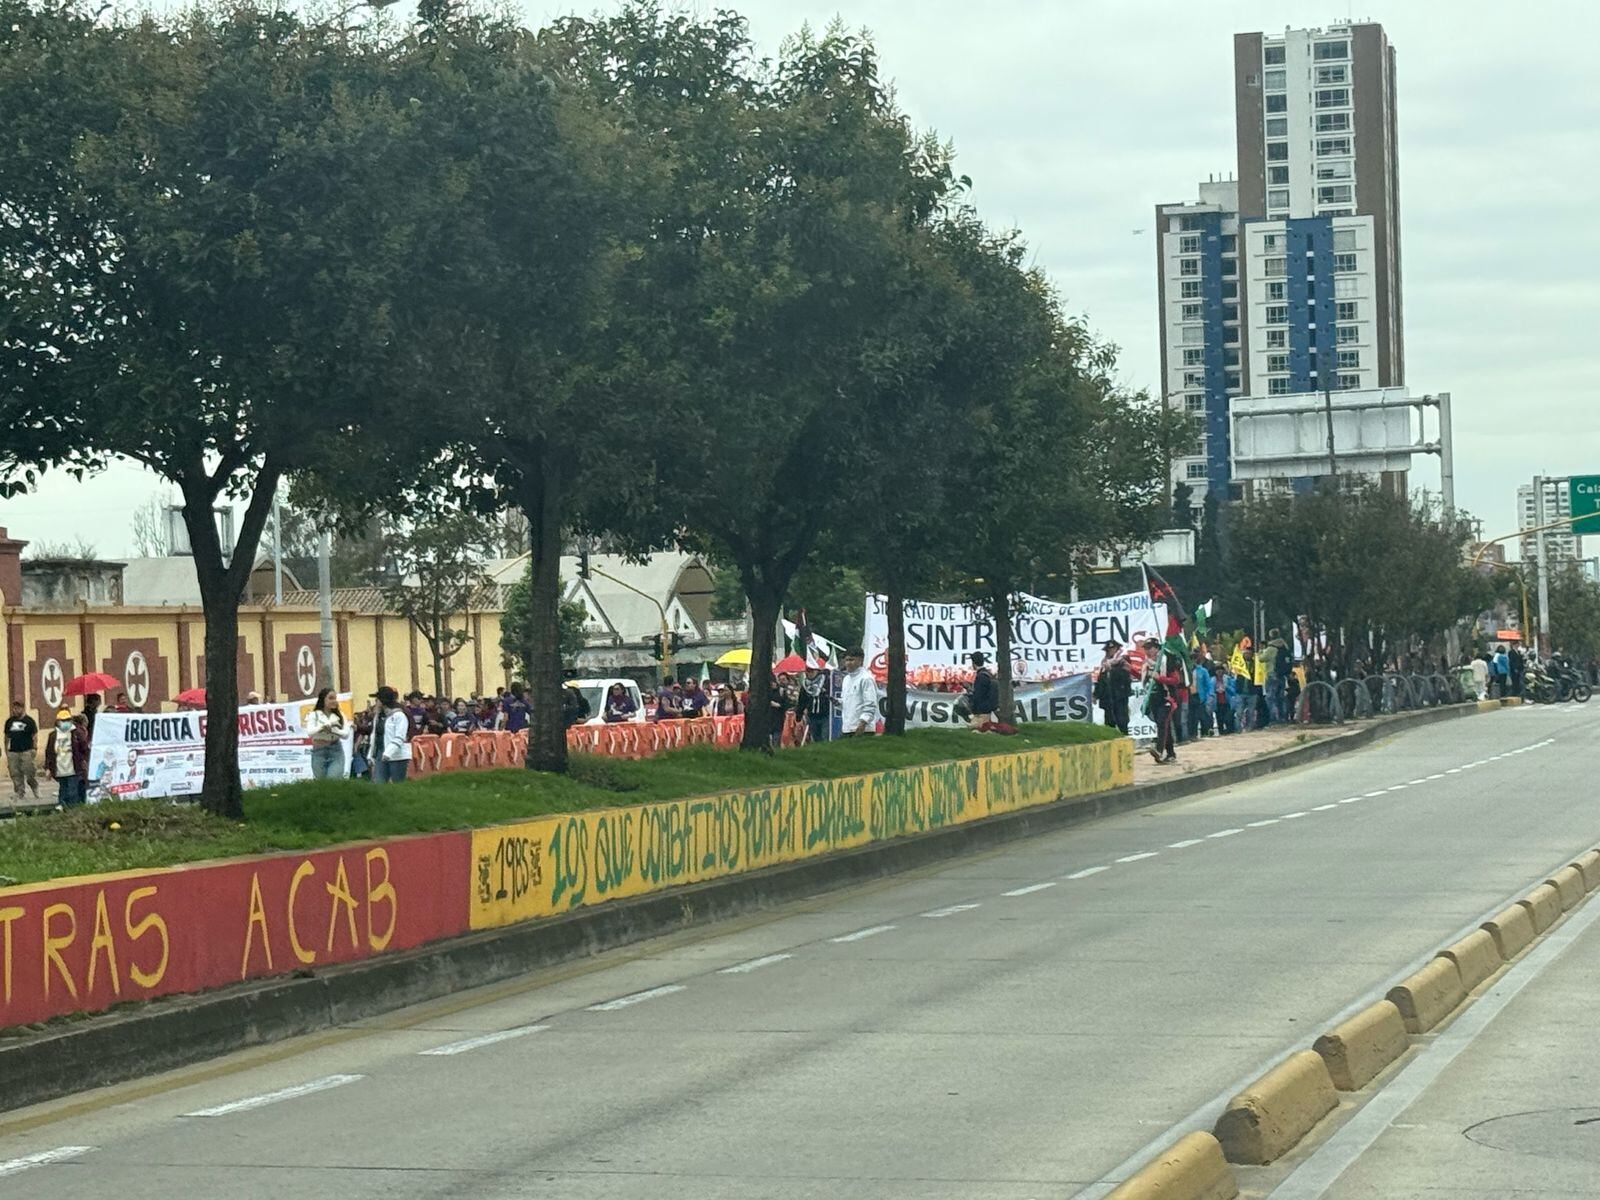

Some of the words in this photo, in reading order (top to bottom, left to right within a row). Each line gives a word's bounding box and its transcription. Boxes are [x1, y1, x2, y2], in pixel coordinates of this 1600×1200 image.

[940, 606, 956, 620] DE
[1080, 596, 1162, 614] COLPENSION
[953, 648, 1085, 664] ¡PRSENTE!
[495, 837, 529, 904] 1985
[594, 813, 635, 893] QUE
[638, 795, 740, 883] COMBATIMOS
[743, 790, 773, 866] POR
[0, 886, 169, 1005] TRAS
[241, 847, 397, 980] ACAB
